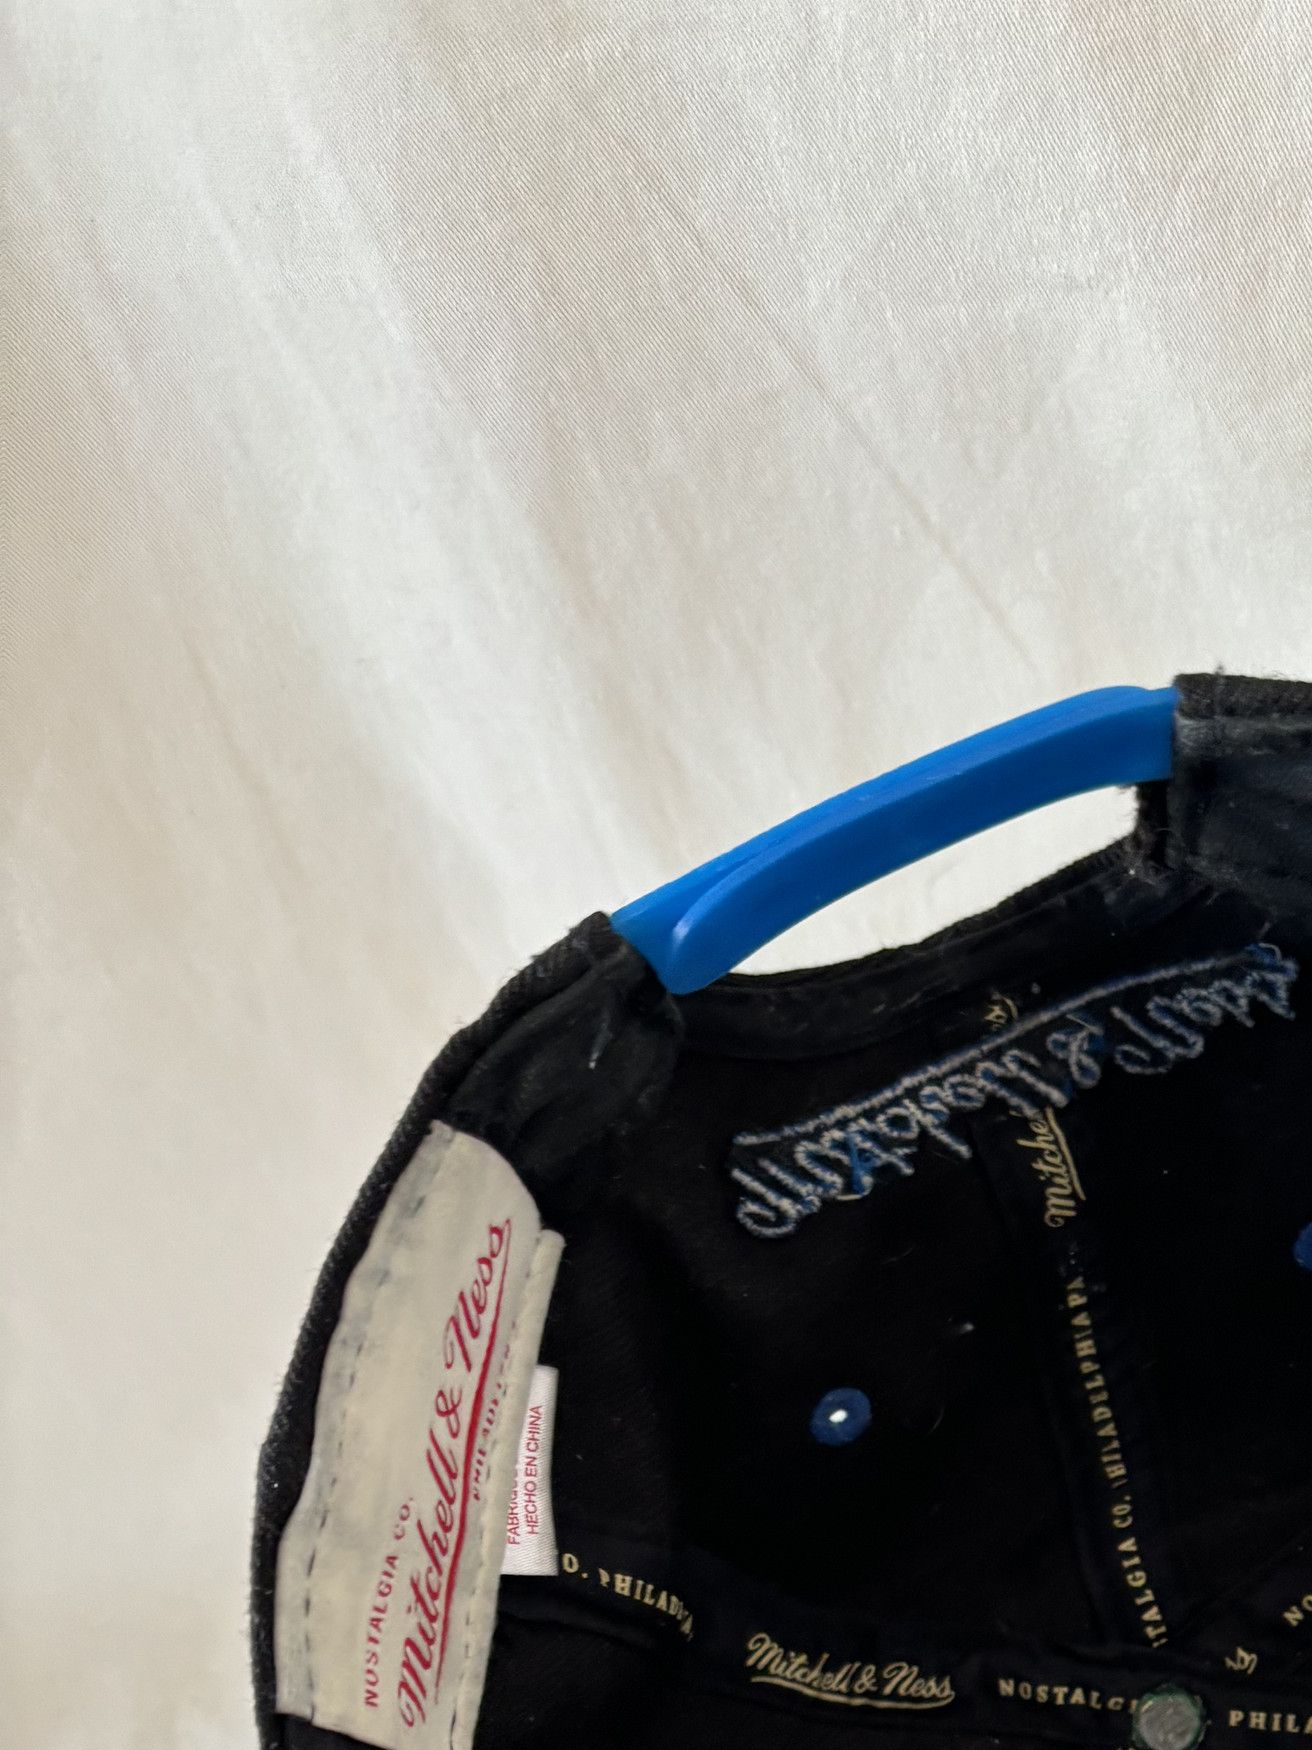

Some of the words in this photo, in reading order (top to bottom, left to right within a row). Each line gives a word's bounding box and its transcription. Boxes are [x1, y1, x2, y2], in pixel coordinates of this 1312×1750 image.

[444, 1217, 512, 1371] Ness
[436, 1388, 464, 1438] &
[524, 1404, 544, 1453] CHINA
[522, 1455, 539, 1479] EN
[523, 1480, 540, 1536] HECHO
[396, 1449, 460, 1729] Mitchell
[362, 1552, 398, 1709] NOSTALGIA
[746, 1632, 851, 1694] Mitchell
[853, 1663, 878, 1694] &
[882, 1661, 955, 1699] Ness
